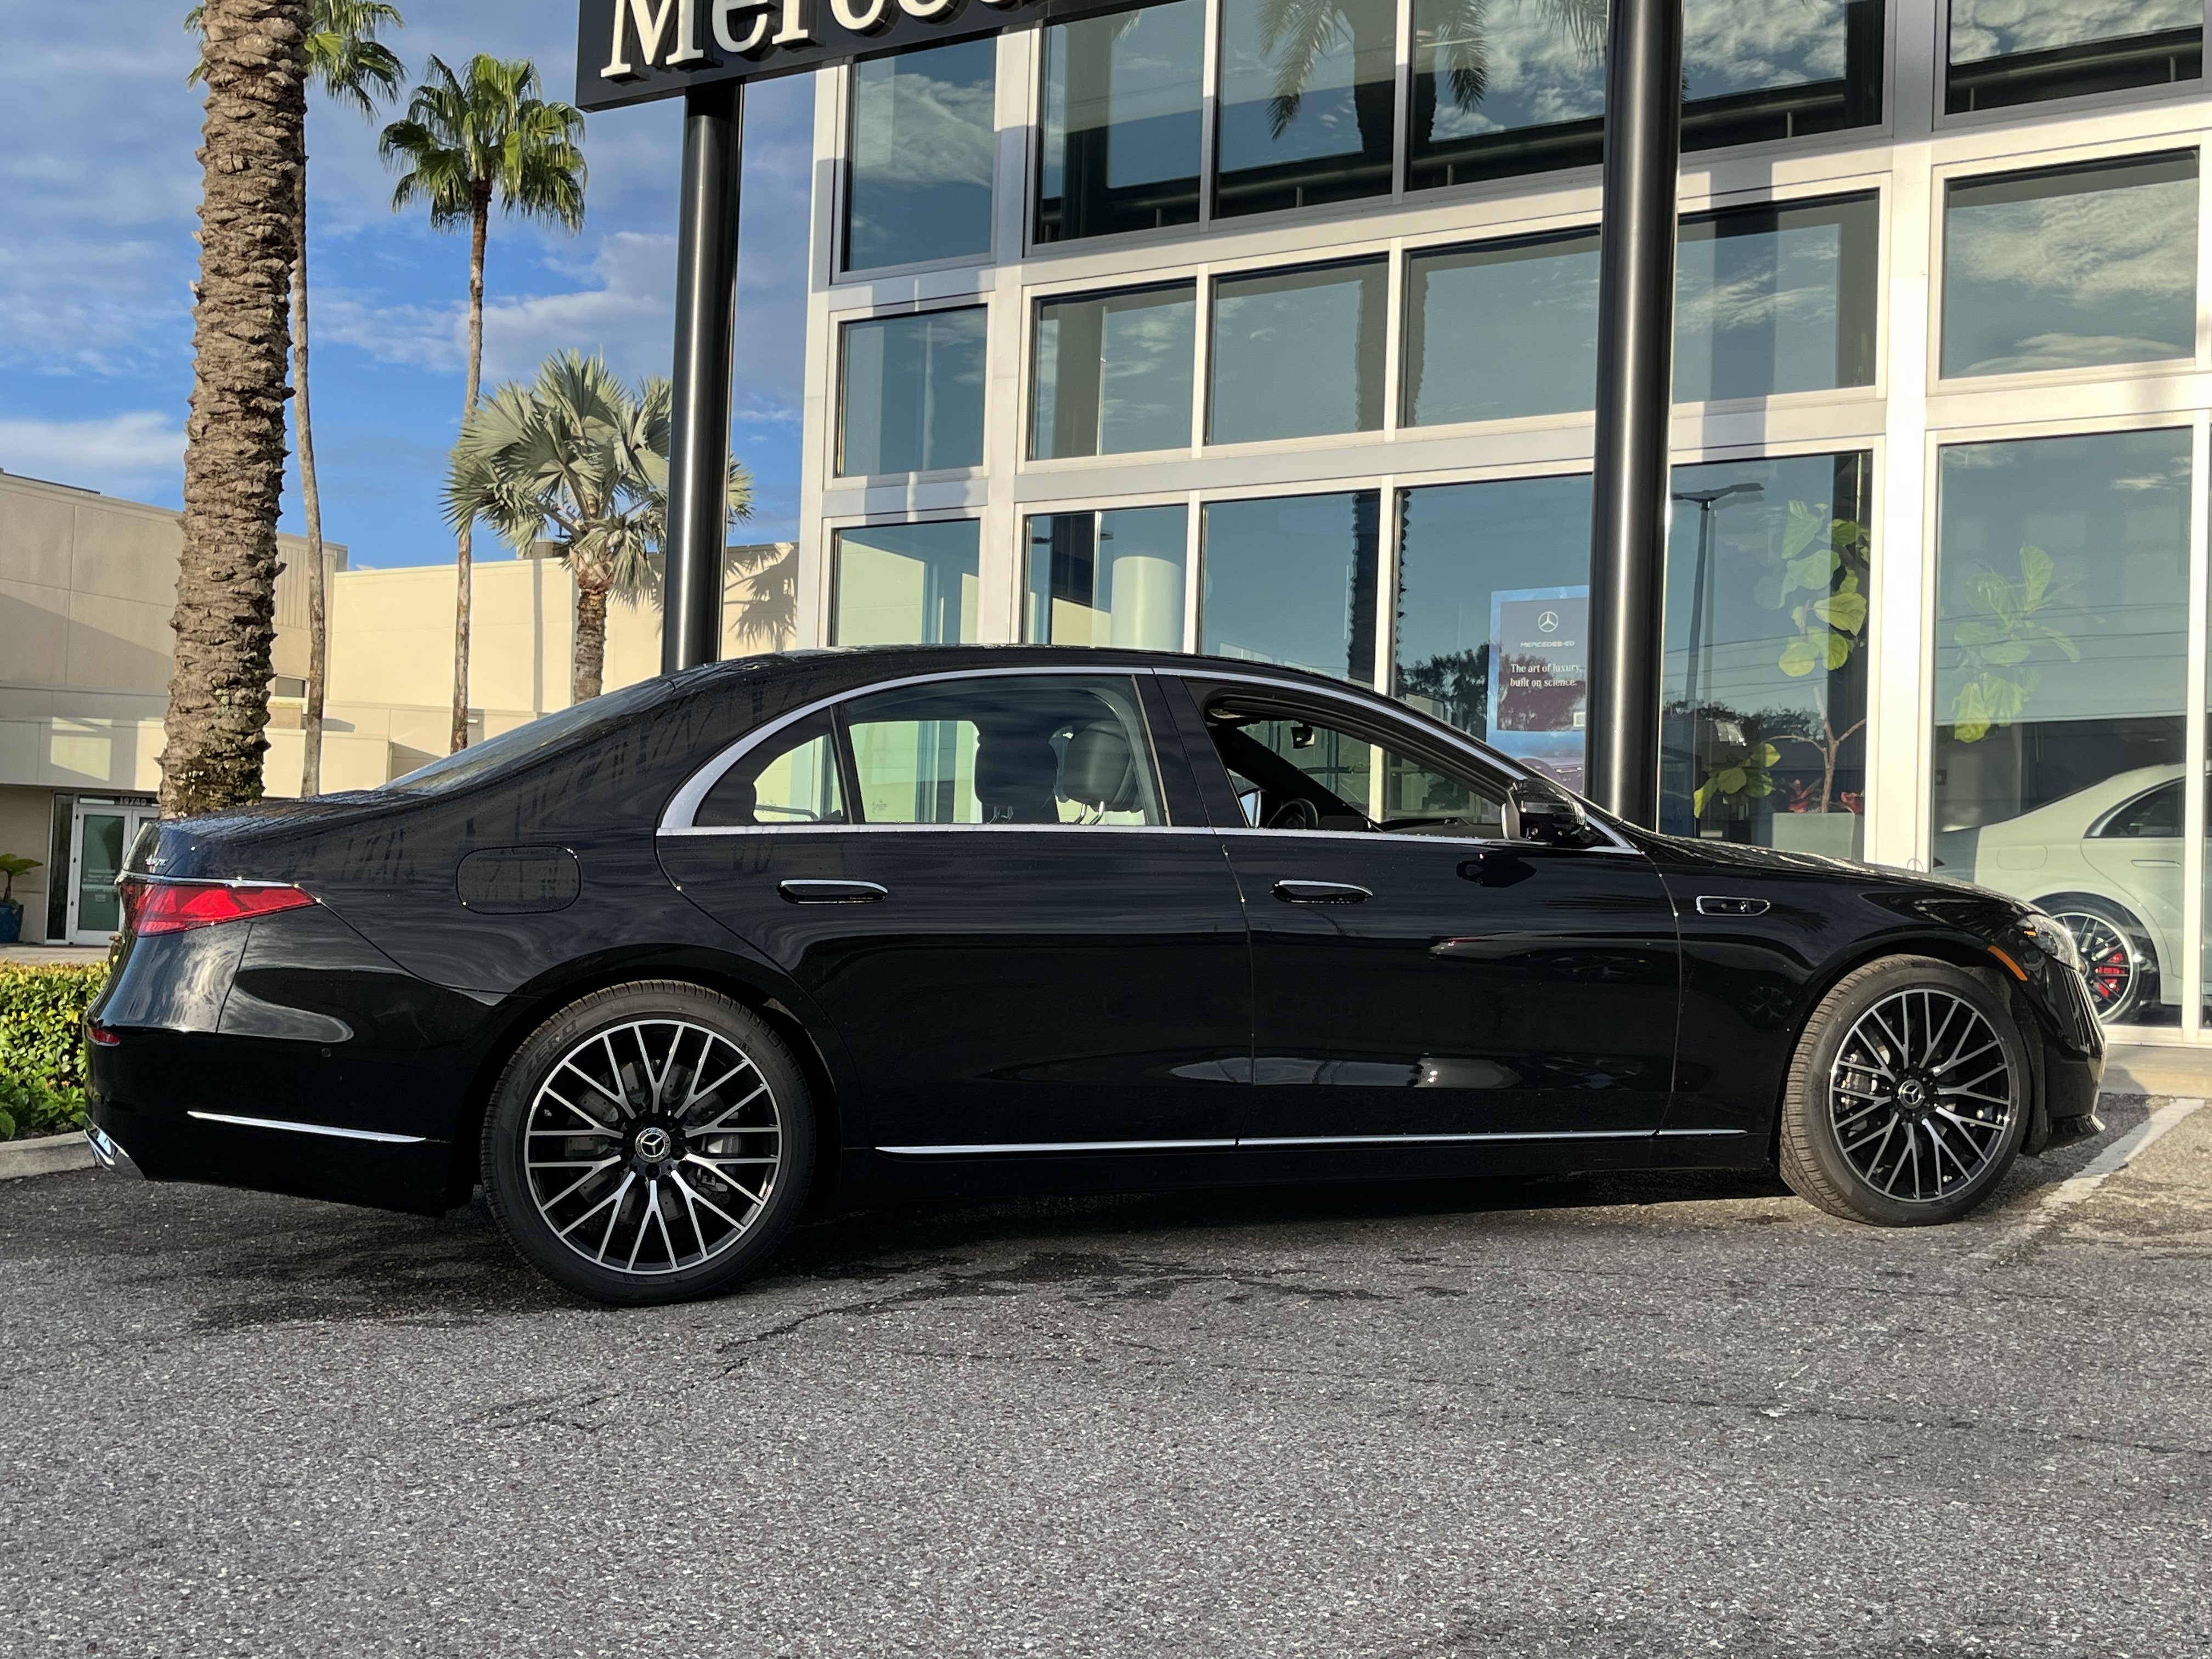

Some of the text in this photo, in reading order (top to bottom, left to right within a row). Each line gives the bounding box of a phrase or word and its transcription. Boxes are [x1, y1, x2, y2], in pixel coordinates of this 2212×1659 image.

[1511, 663, 1582, 674] The art of luxury,
[1510, 676, 1530, 687] built
[1544, 678, 1577, 687] science.
